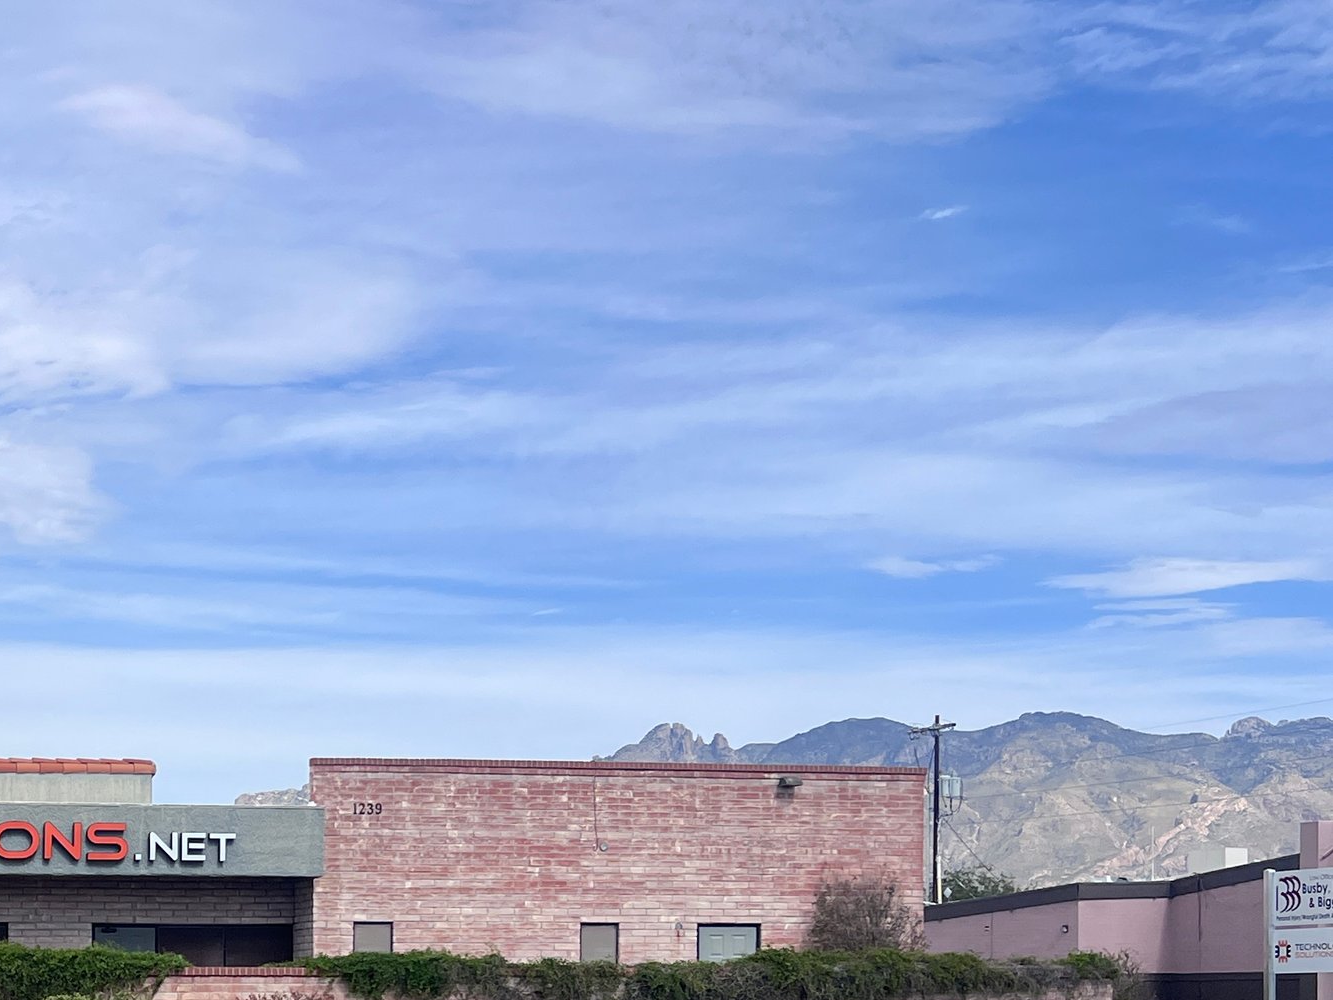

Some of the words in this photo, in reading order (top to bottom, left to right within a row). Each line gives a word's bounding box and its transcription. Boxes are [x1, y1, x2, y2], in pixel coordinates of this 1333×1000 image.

[353, 802, 383, 815] 1239
[1309, 897, 1315, 908] &
[1295, 942, 1333, 951] TECHNOL
